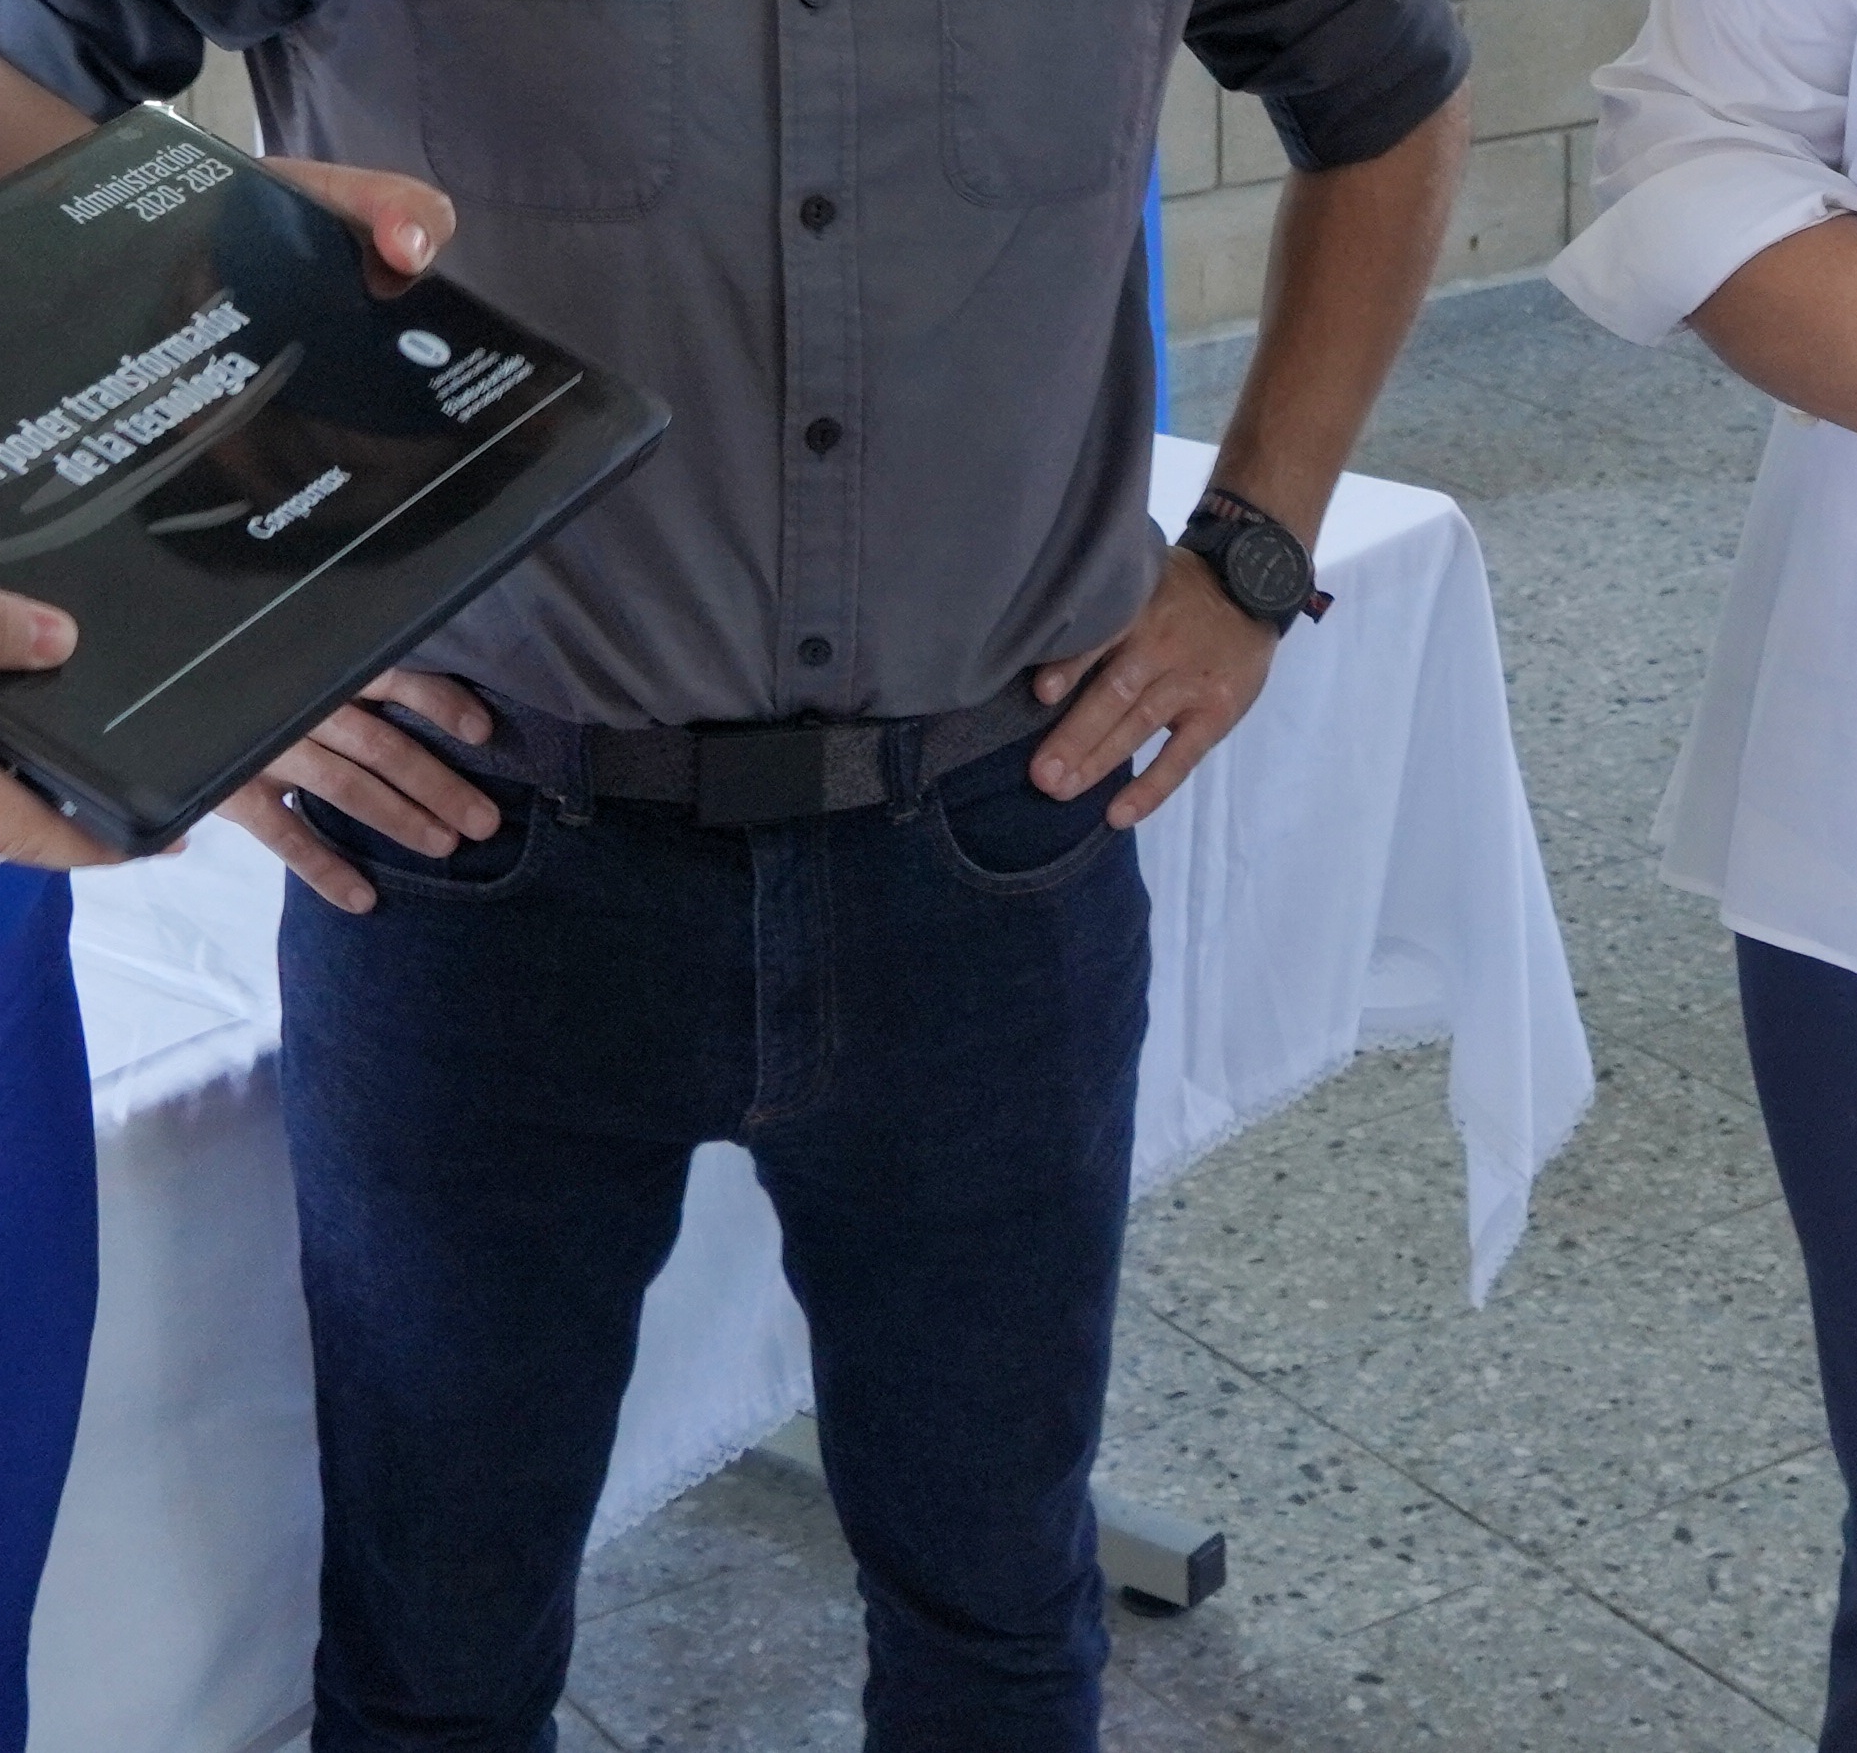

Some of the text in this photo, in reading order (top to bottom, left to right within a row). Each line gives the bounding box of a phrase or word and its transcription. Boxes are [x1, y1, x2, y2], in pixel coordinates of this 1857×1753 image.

[60, 142, 206, 225] Administración
[176, 158, 234, 193] 2023
[61, 300, 251, 422] transformador
[52, 351, 260, 487] de la tecnología
